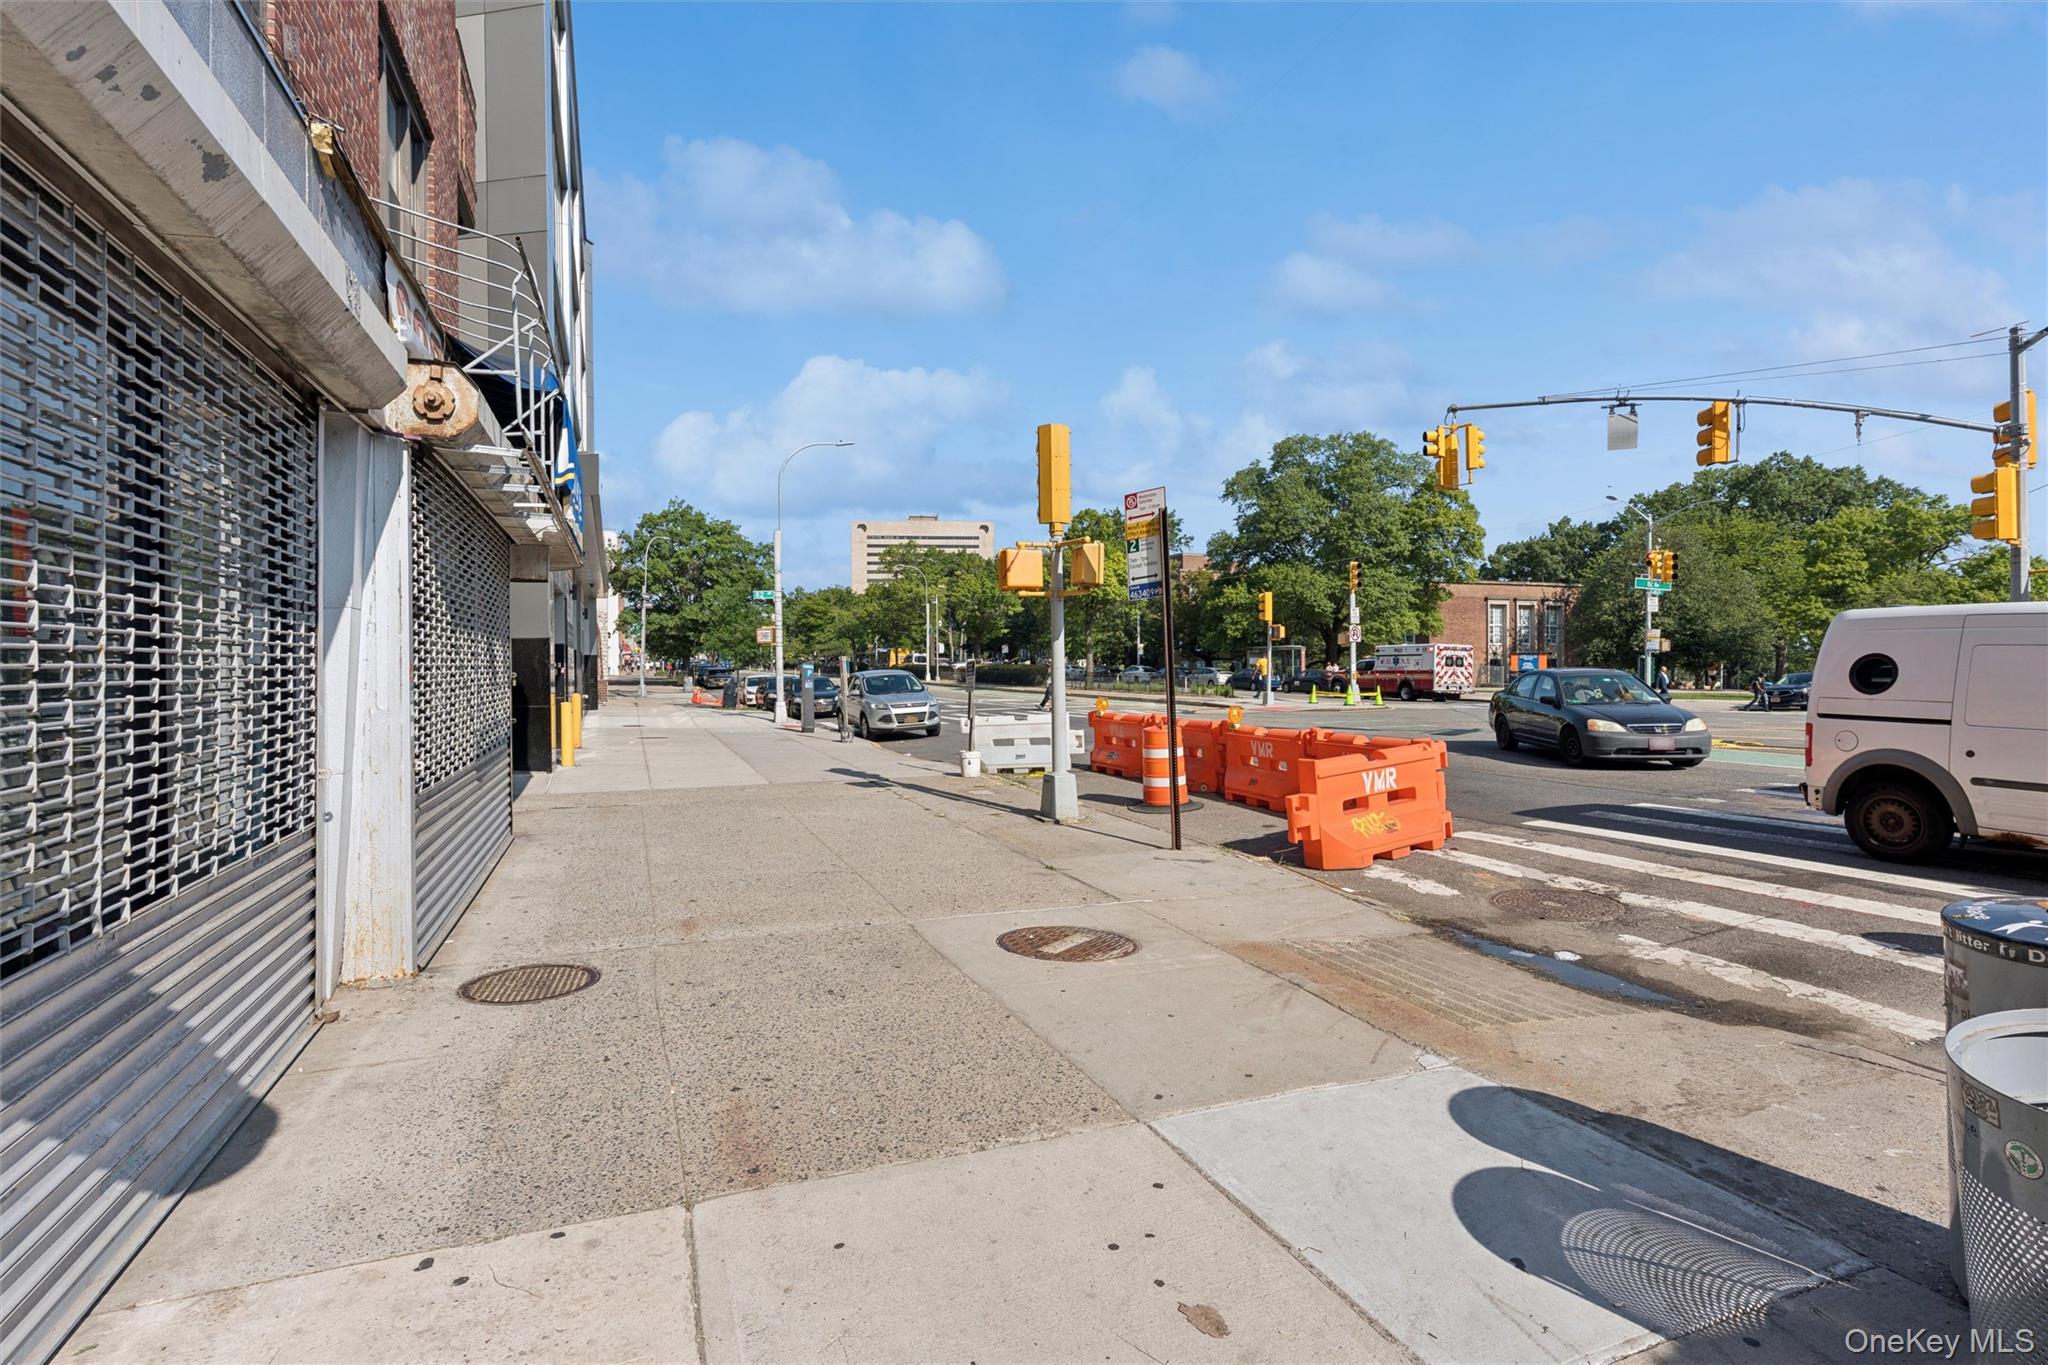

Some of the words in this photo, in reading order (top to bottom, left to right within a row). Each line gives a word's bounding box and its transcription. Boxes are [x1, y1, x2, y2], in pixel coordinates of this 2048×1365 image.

[1129, 540, 1137, 552] 2
[1361, 767, 1397, 795] VMR
[1955, 929, 1990, 952] litter
